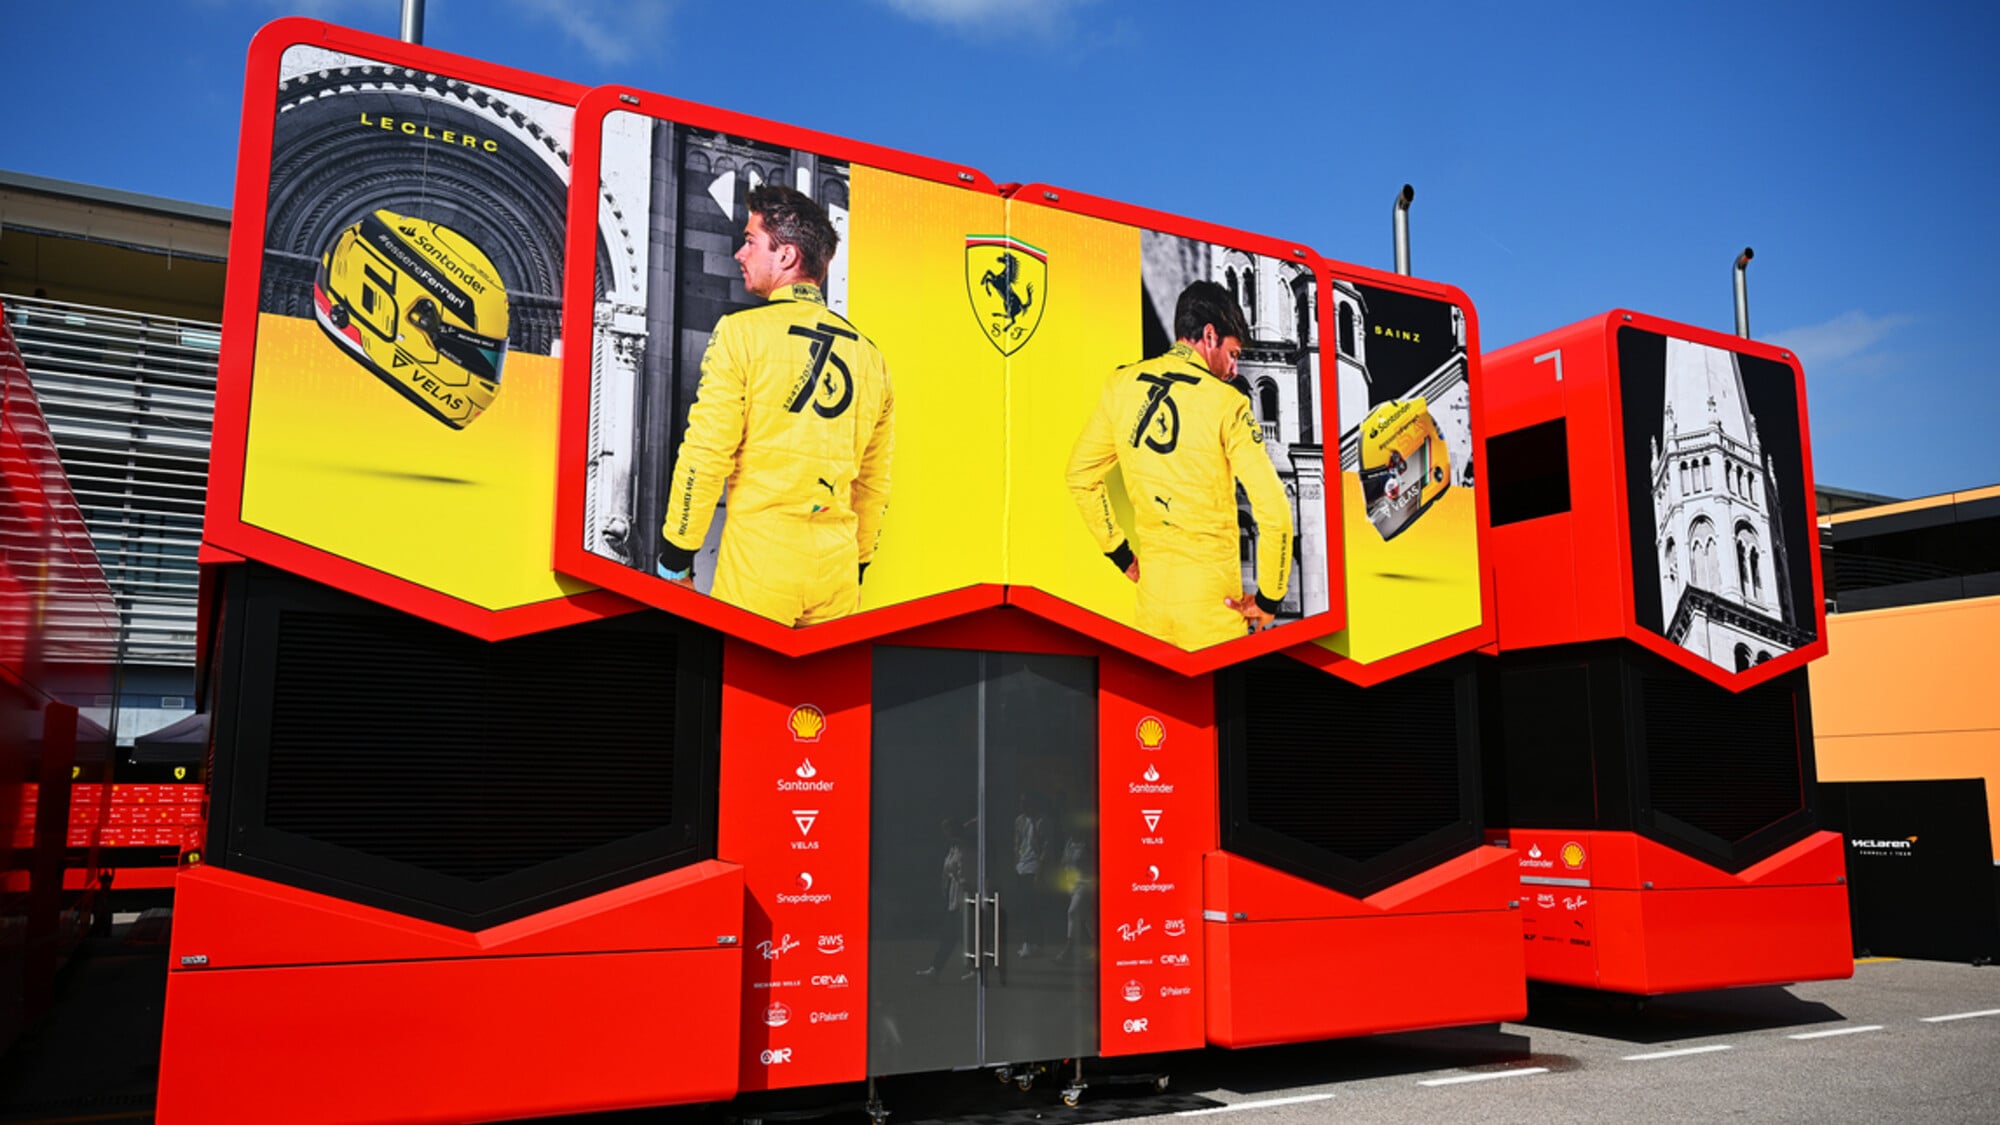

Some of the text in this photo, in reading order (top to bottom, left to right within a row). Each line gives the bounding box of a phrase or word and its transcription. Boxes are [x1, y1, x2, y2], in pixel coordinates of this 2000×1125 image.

[360, 112, 500, 153] LECLERC
[413, 235, 487, 295] Santander
[378, 234, 466, 309] #essereFerrari
[1374, 325, 1421, 343] SAINZ
[776, 779, 834, 791] Santander
[1129, 783, 1174, 793] Santander
[791, 841, 819, 850] VELAS
[1851, 839, 1911, 848] McLaren
[1131, 883, 1175, 893] Snapdragon
[776, 893, 832, 904] Snapdragon
[818, 934, 844, 947] aws
